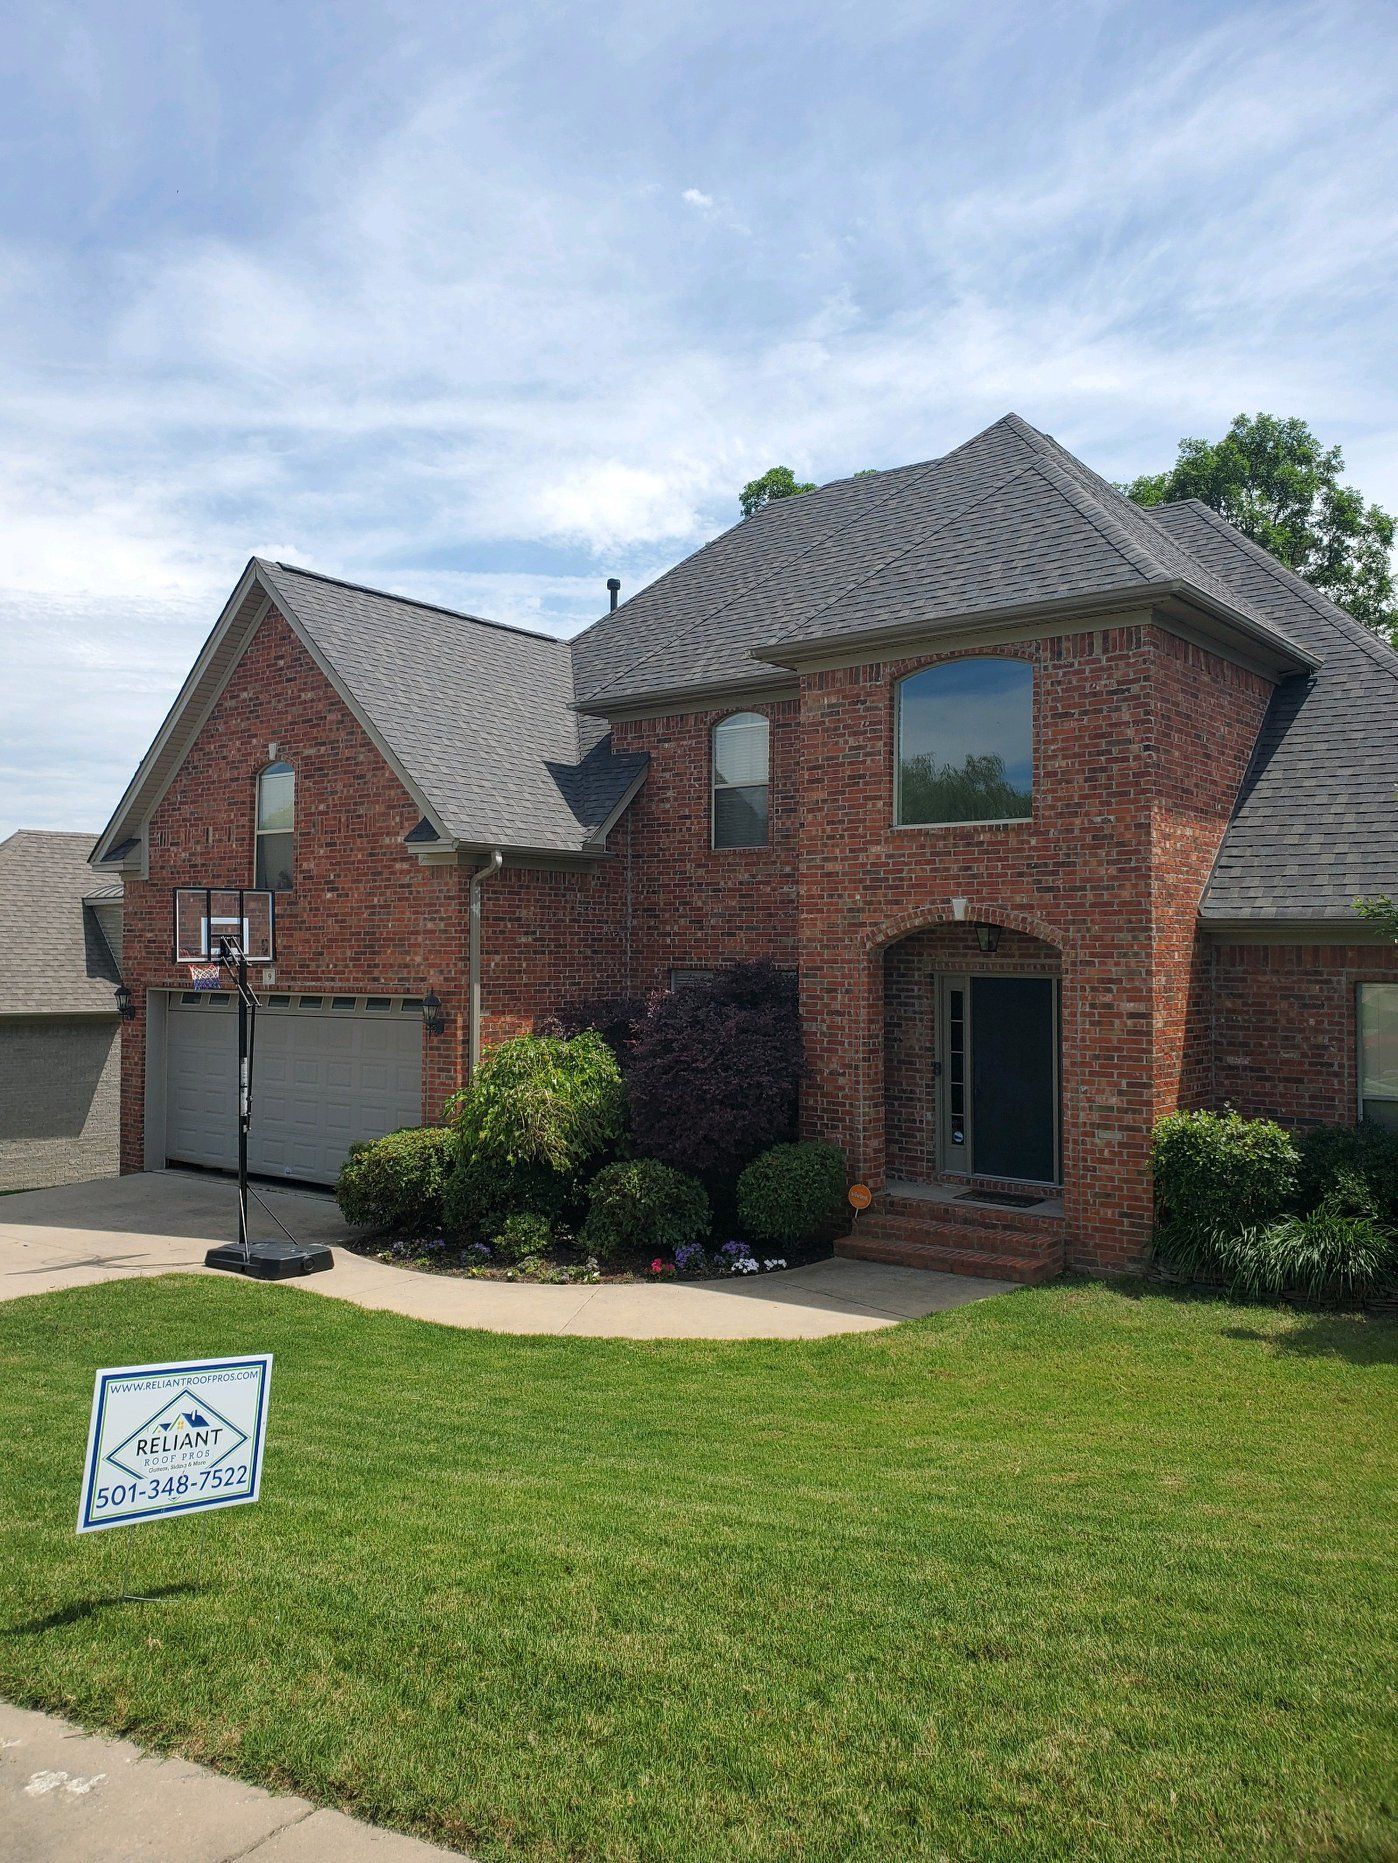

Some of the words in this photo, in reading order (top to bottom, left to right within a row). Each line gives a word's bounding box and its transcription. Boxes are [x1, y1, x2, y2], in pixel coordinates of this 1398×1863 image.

[268, 973, 272, 981] 9
[110, 1371, 258, 1394] WWW.RELIANTROOFPROS.COM
[136, 1428, 223, 1456] RELIANT
[144, 1454, 176, 1467] ROOF
[182, 1449, 210, 1461] PROS
[96, 1465, 248, 1509] 501-348-7522
